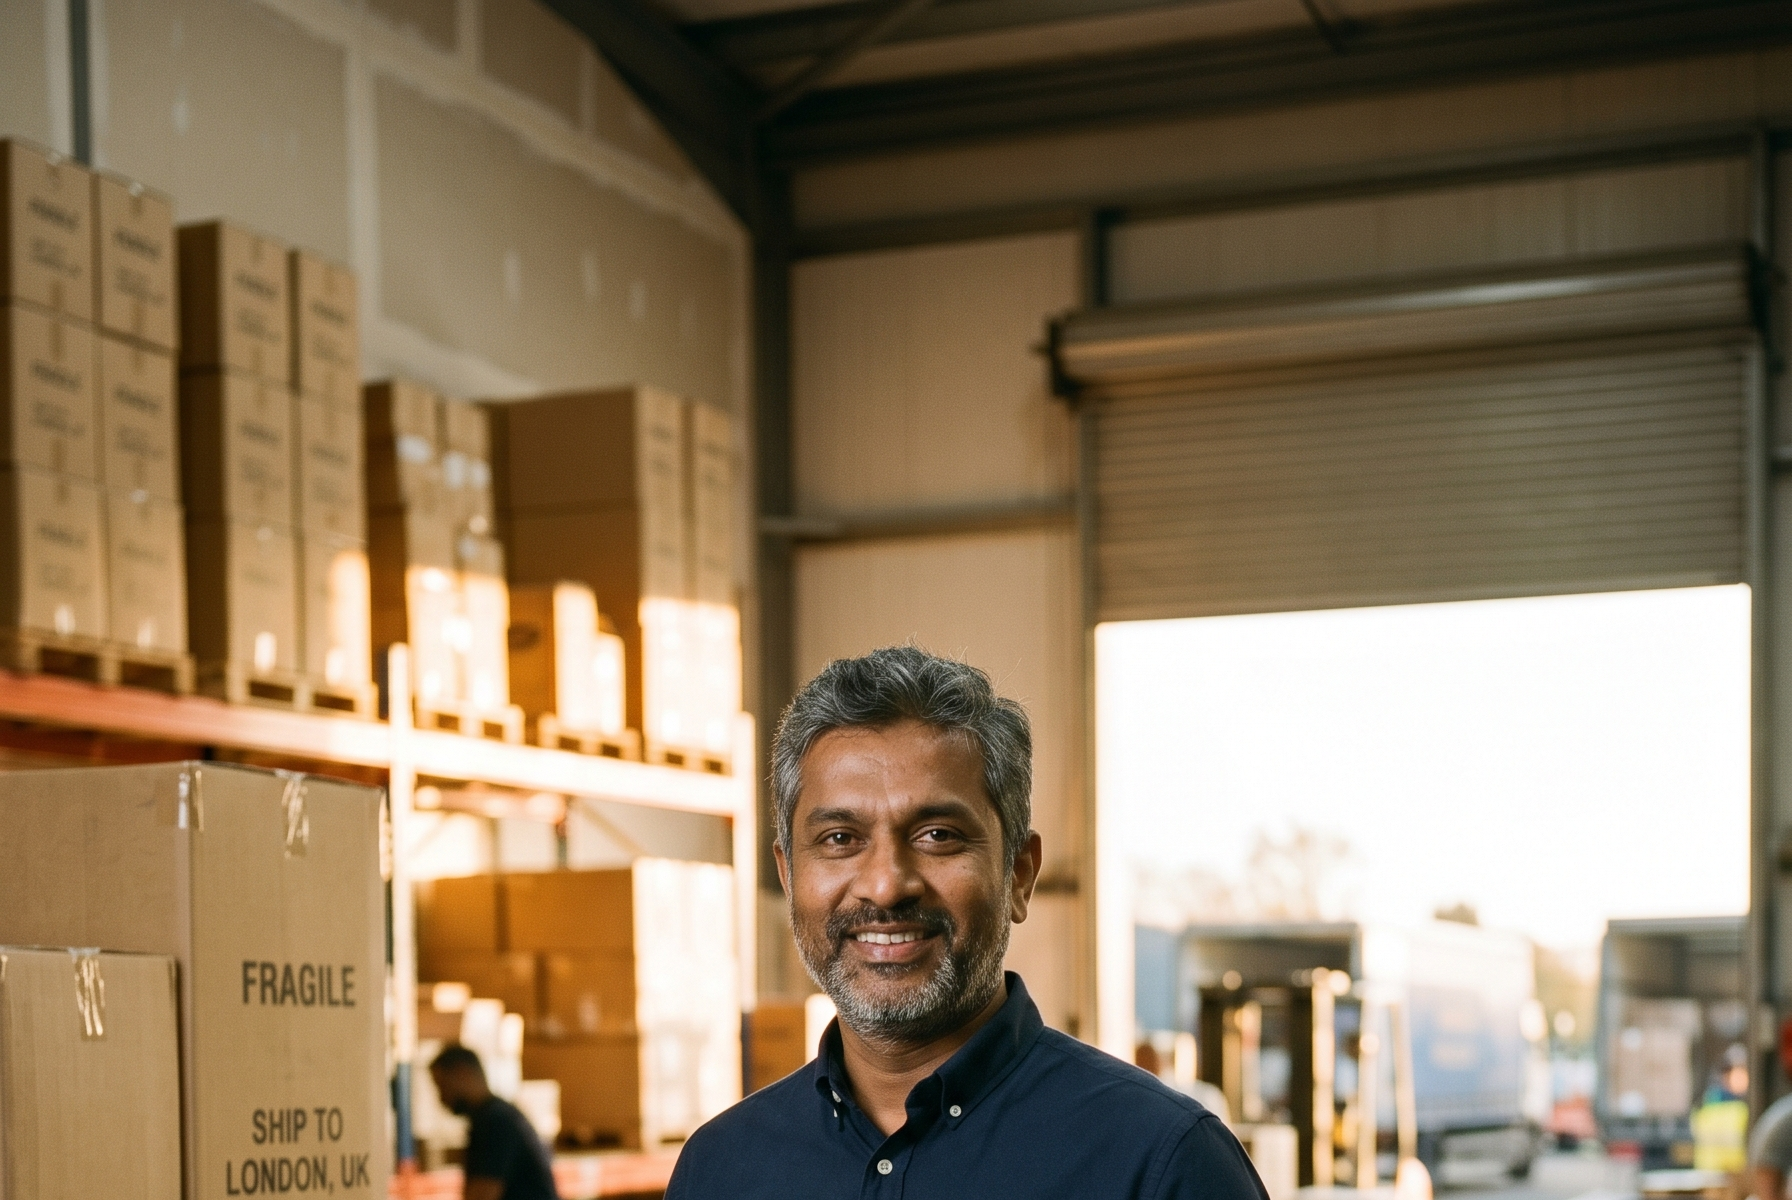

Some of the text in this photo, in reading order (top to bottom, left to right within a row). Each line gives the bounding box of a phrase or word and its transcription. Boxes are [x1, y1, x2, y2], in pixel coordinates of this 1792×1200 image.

[241, 959, 357, 1009] FRAGILE
[251, 1106, 344, 1145] SHIP TO
[226, 1153, 371, 1197] LONDON, UK
